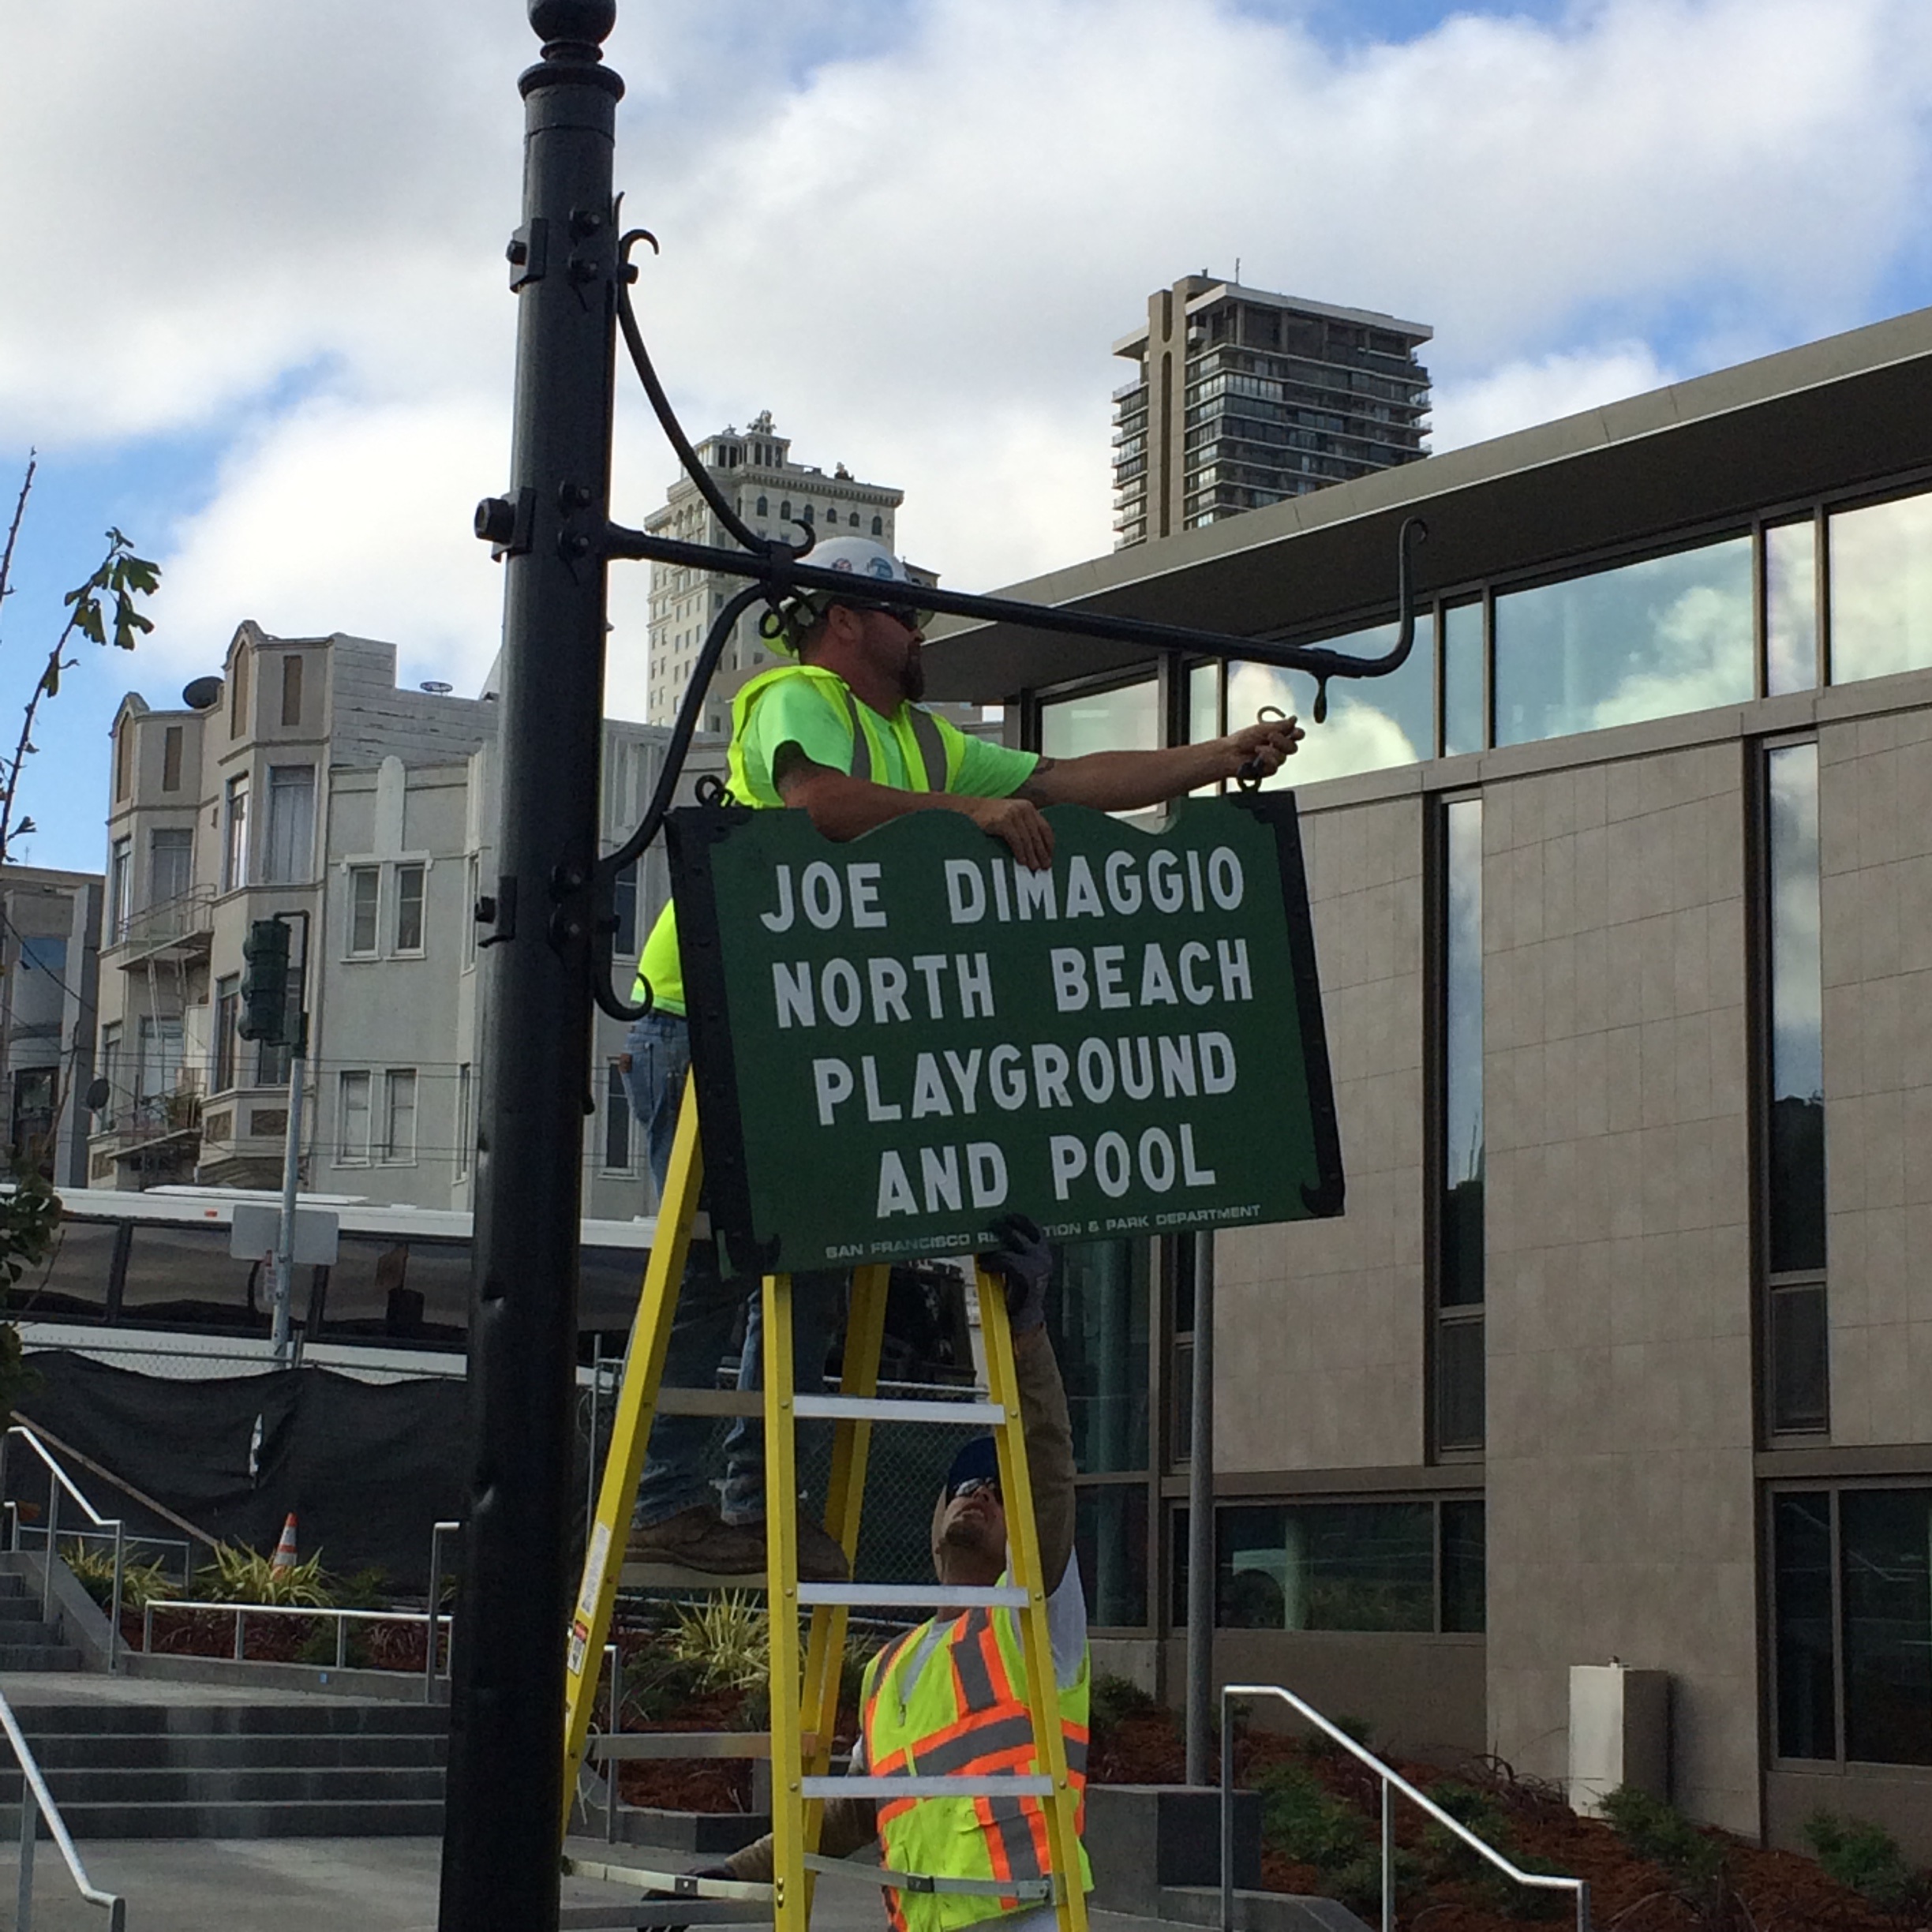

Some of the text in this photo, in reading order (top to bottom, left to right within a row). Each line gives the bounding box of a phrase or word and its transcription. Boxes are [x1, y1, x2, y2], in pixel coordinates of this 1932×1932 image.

[760, 846, 1244, 932] JOE DIMAGGIO
[772, 939, 1252, 1028] NORTH BEACH
[813, 1032, 1237, 1126] PLAYGROUND
[877, 1123, 1215, 1219] AND POOL
[826, 1204, 1260, 1260] SAN FRANCISCO RTION & PARK DEPARTMENT
